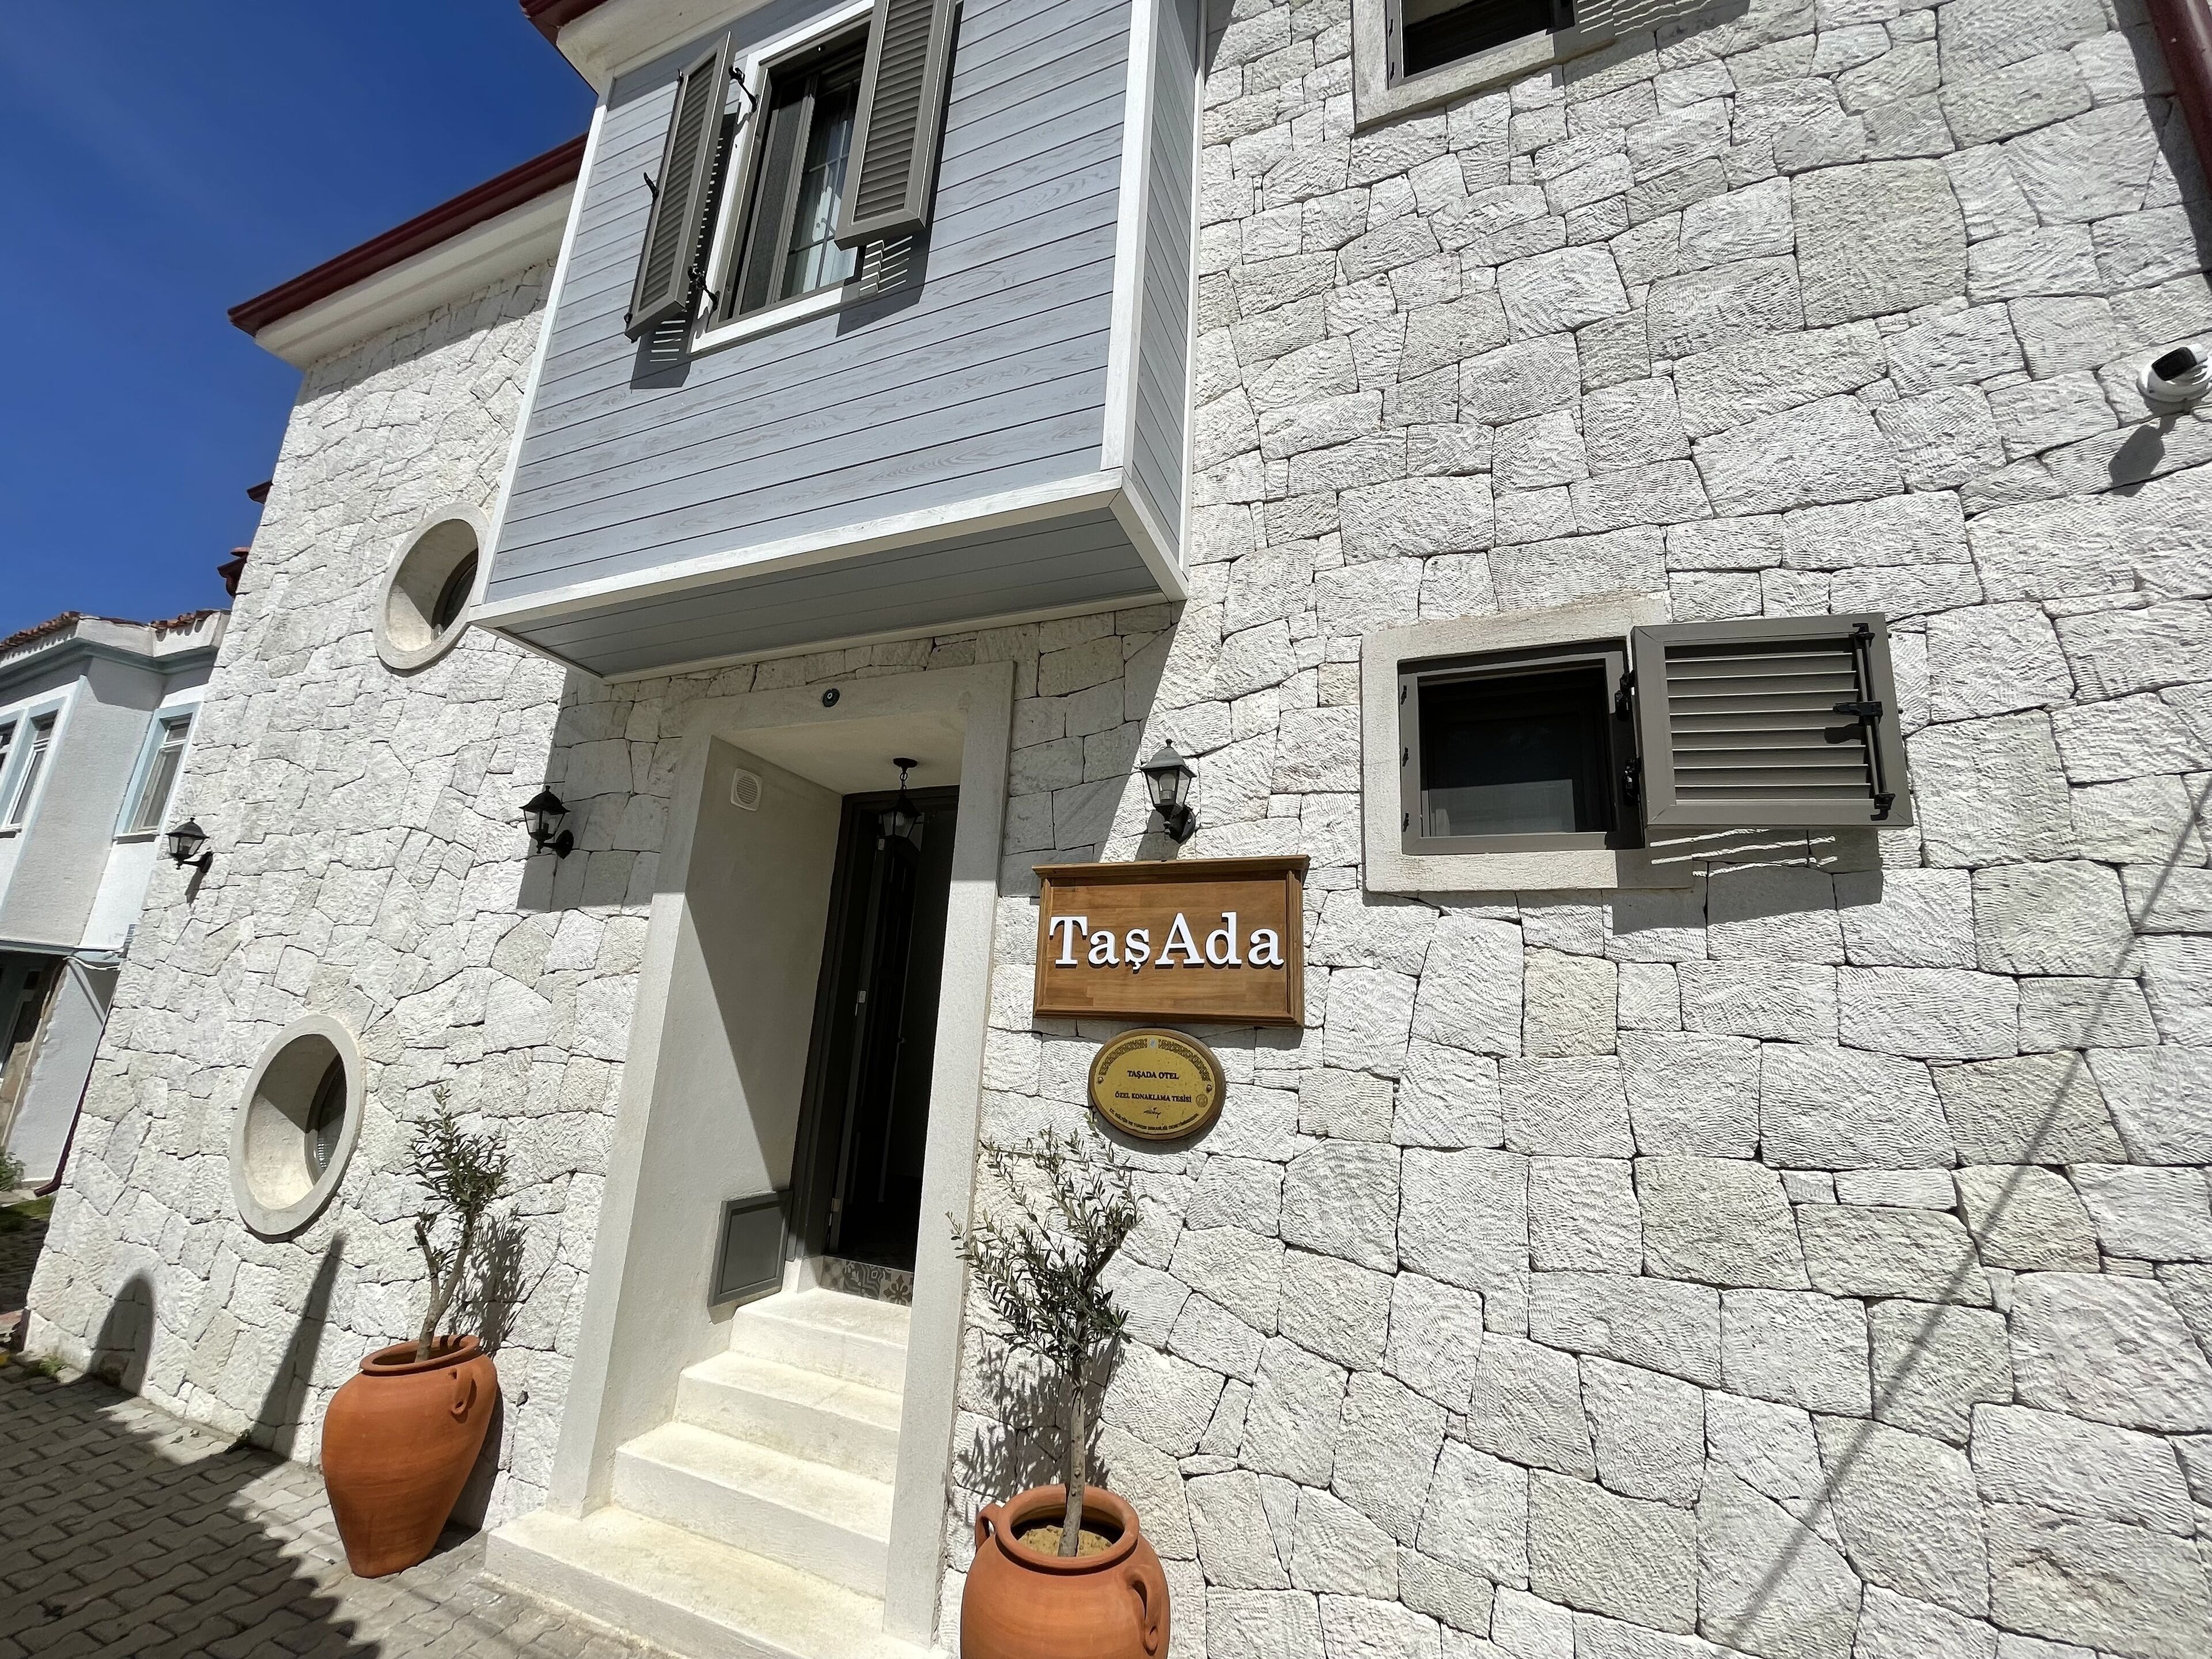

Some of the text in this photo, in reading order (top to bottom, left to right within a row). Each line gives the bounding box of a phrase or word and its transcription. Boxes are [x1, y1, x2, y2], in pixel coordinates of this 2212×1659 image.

[1050, 911, 1284, 969] TaşAda
[1127, 1070, 1179, 1080] TAŞADA OTEL
[1115, 1091, 1192, 1103] ÖZEL KONAKLAMA TESİSİ
